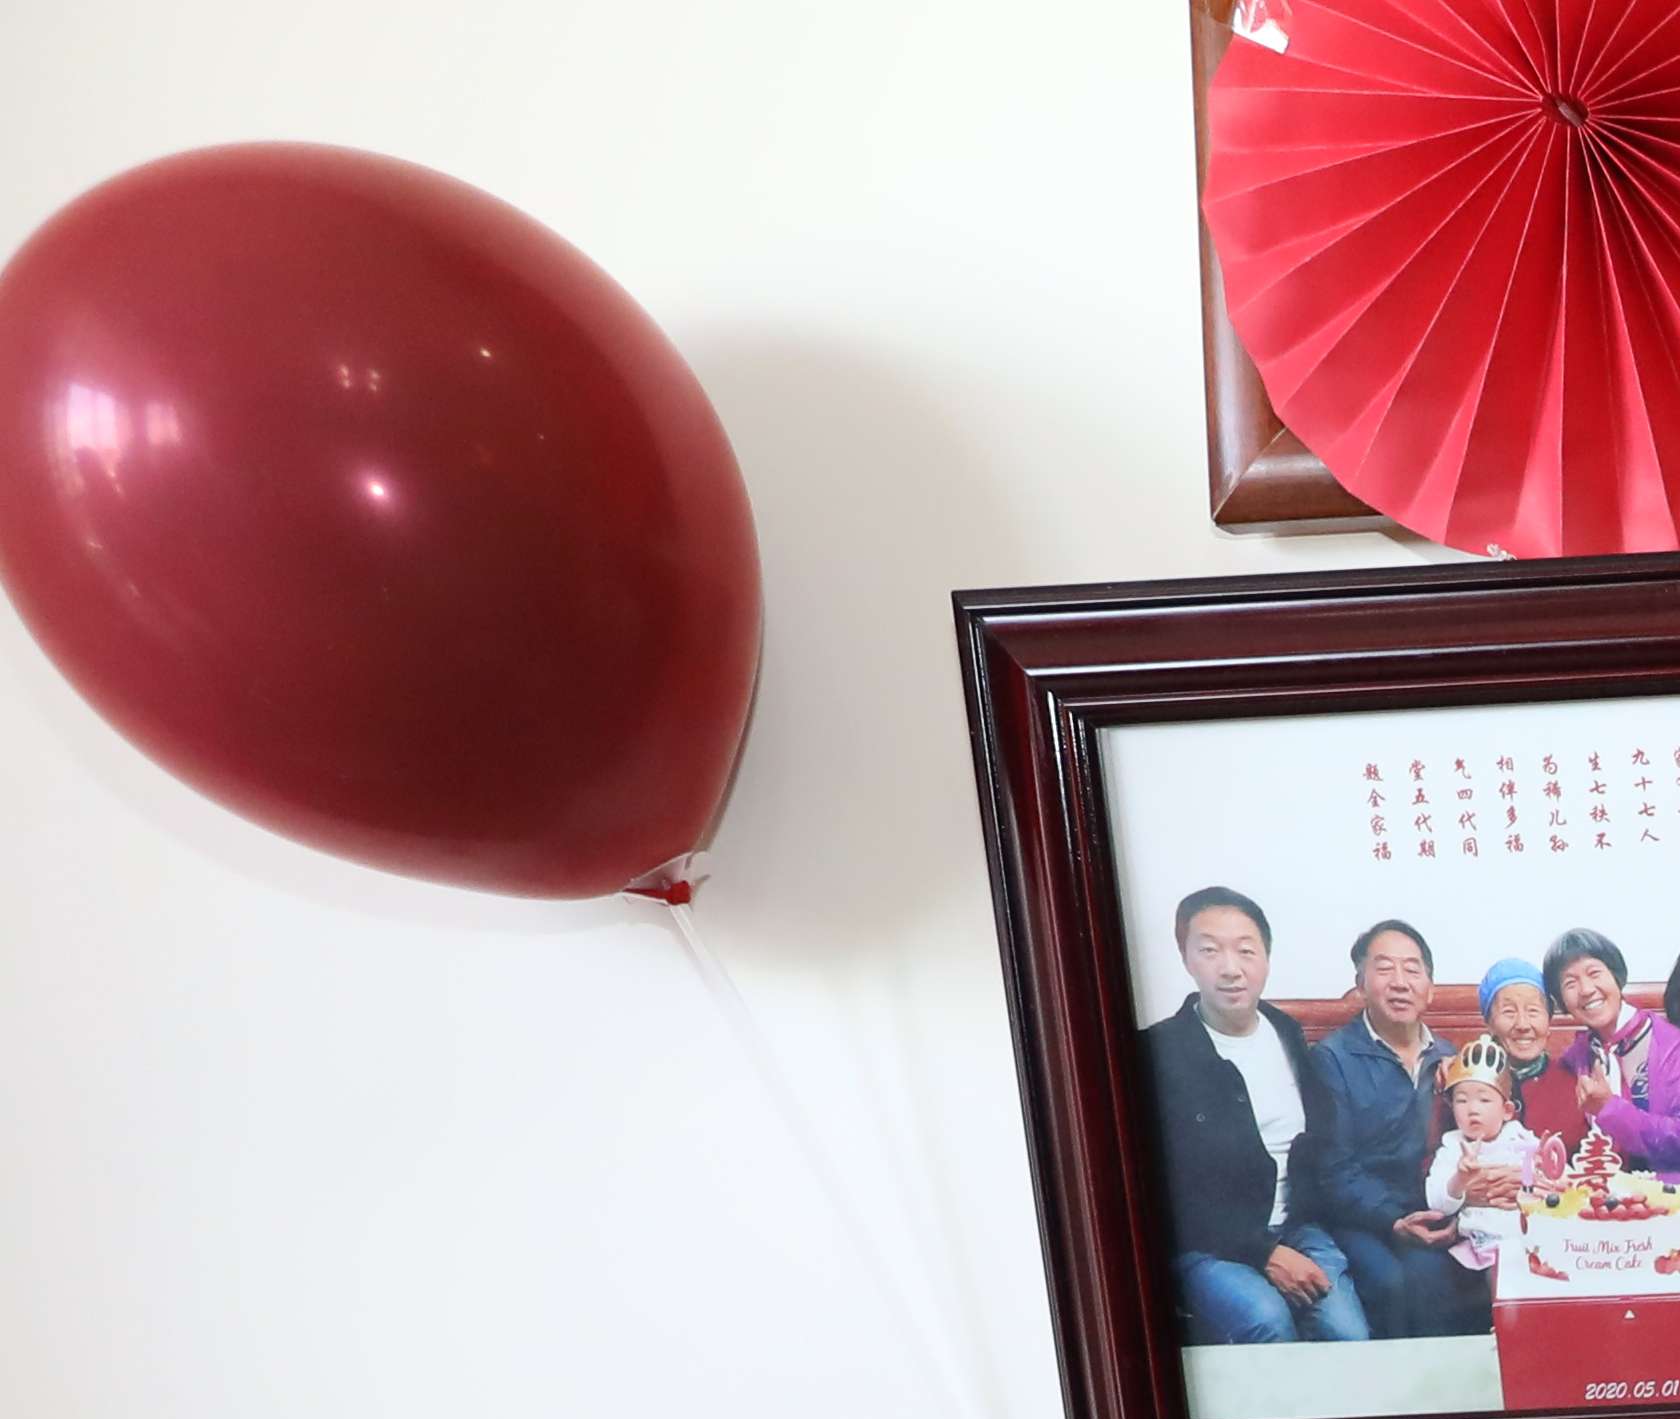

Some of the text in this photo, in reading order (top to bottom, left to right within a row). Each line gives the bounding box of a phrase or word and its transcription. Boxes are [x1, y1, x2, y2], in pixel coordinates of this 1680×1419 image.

[1631, 748, 1661, 843] 九十七人
[1584, 1380, 1680, 1400] 2020.05.01
